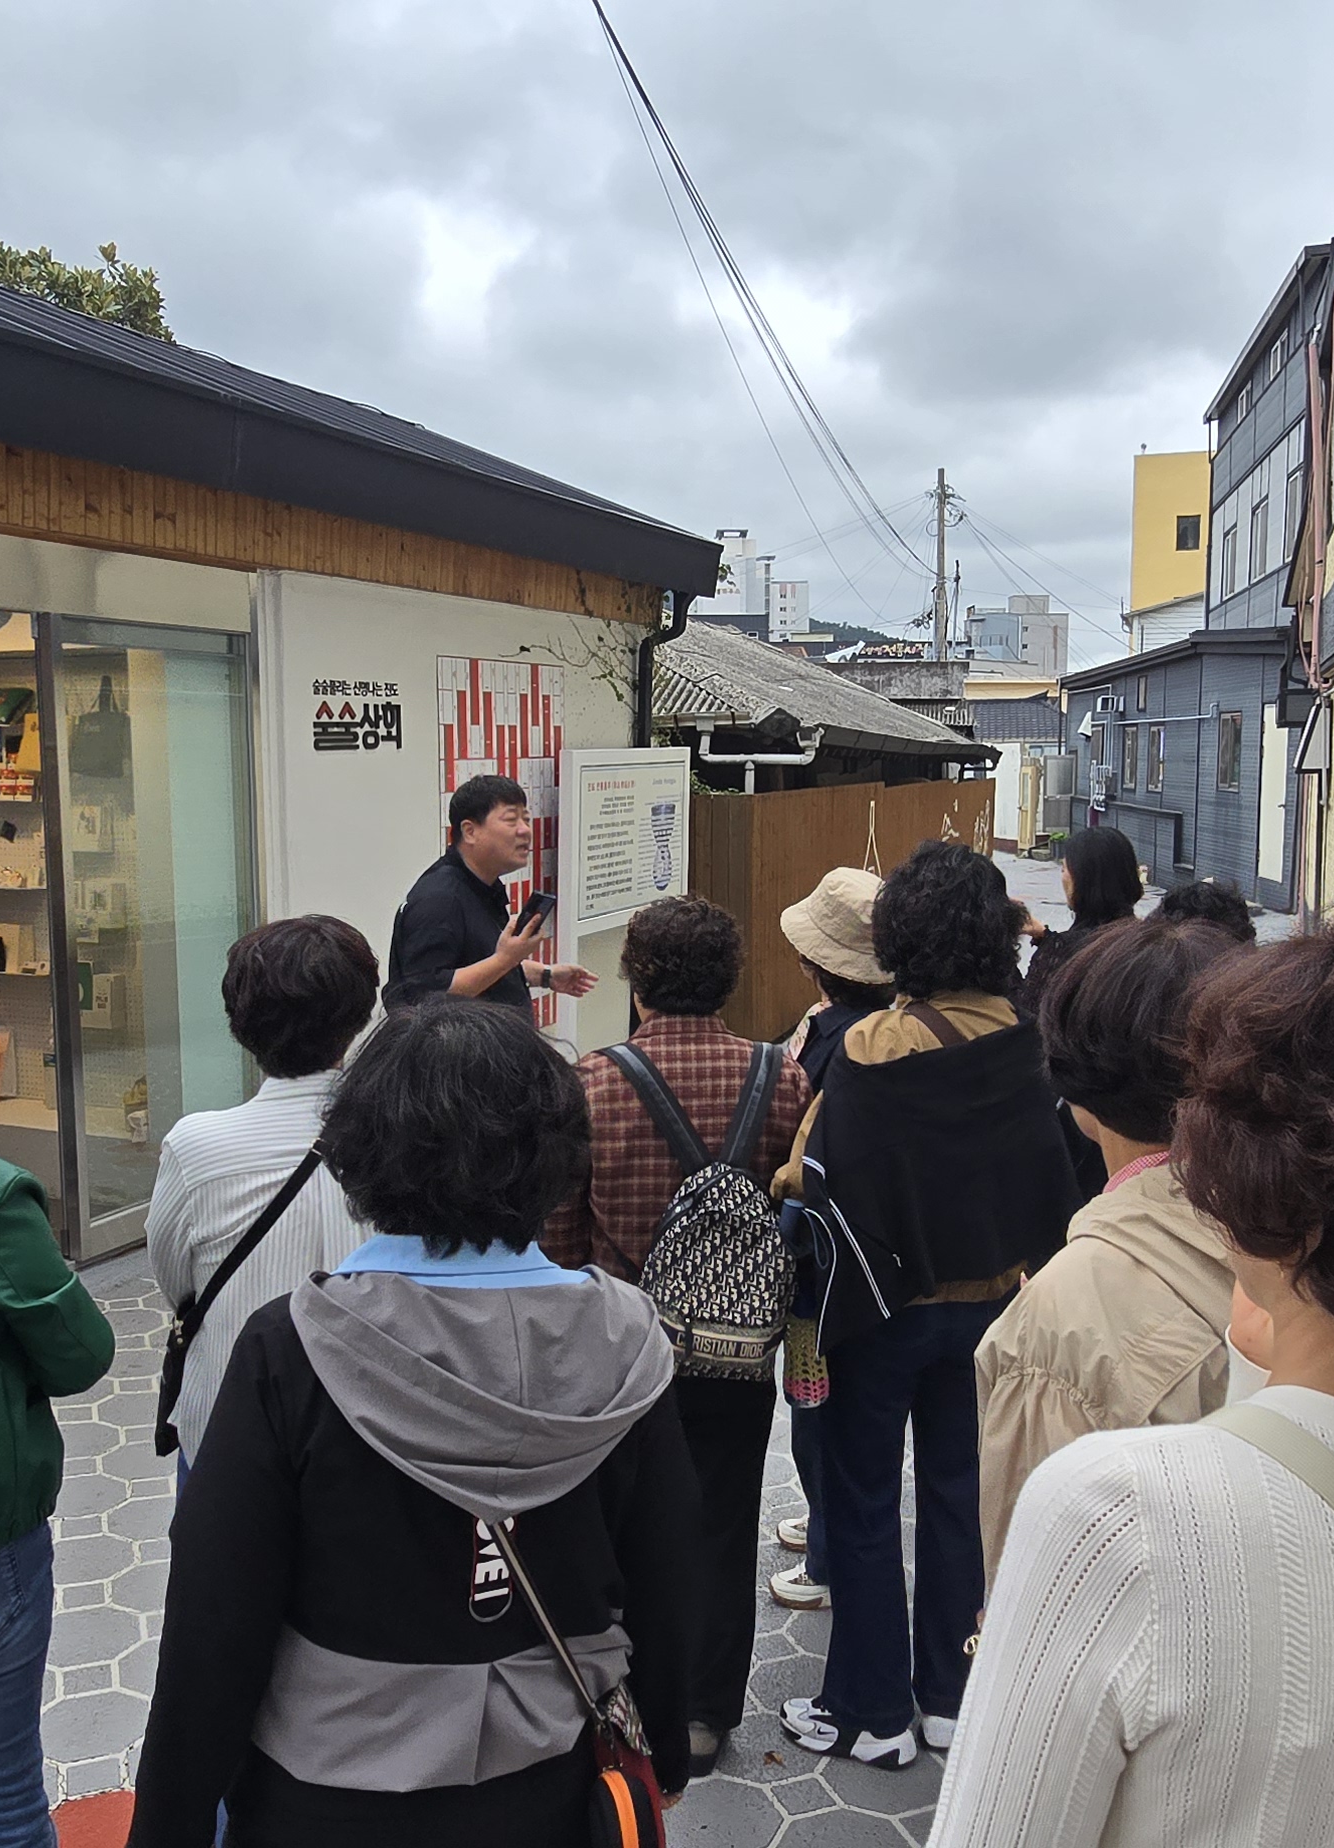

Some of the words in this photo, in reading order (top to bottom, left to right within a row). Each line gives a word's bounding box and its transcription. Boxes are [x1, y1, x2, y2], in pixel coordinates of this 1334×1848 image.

[312, 678, 352, 696] 술술풀리는
[353, 681, 383, 697] 신명나는
[384, 682, 400, 697] 진도
[313, 700, 403, 751] 술술상회
[677, 1332, 737, 1357] CRISTIAN
[739, 1343, 765, 1358] DIOR
